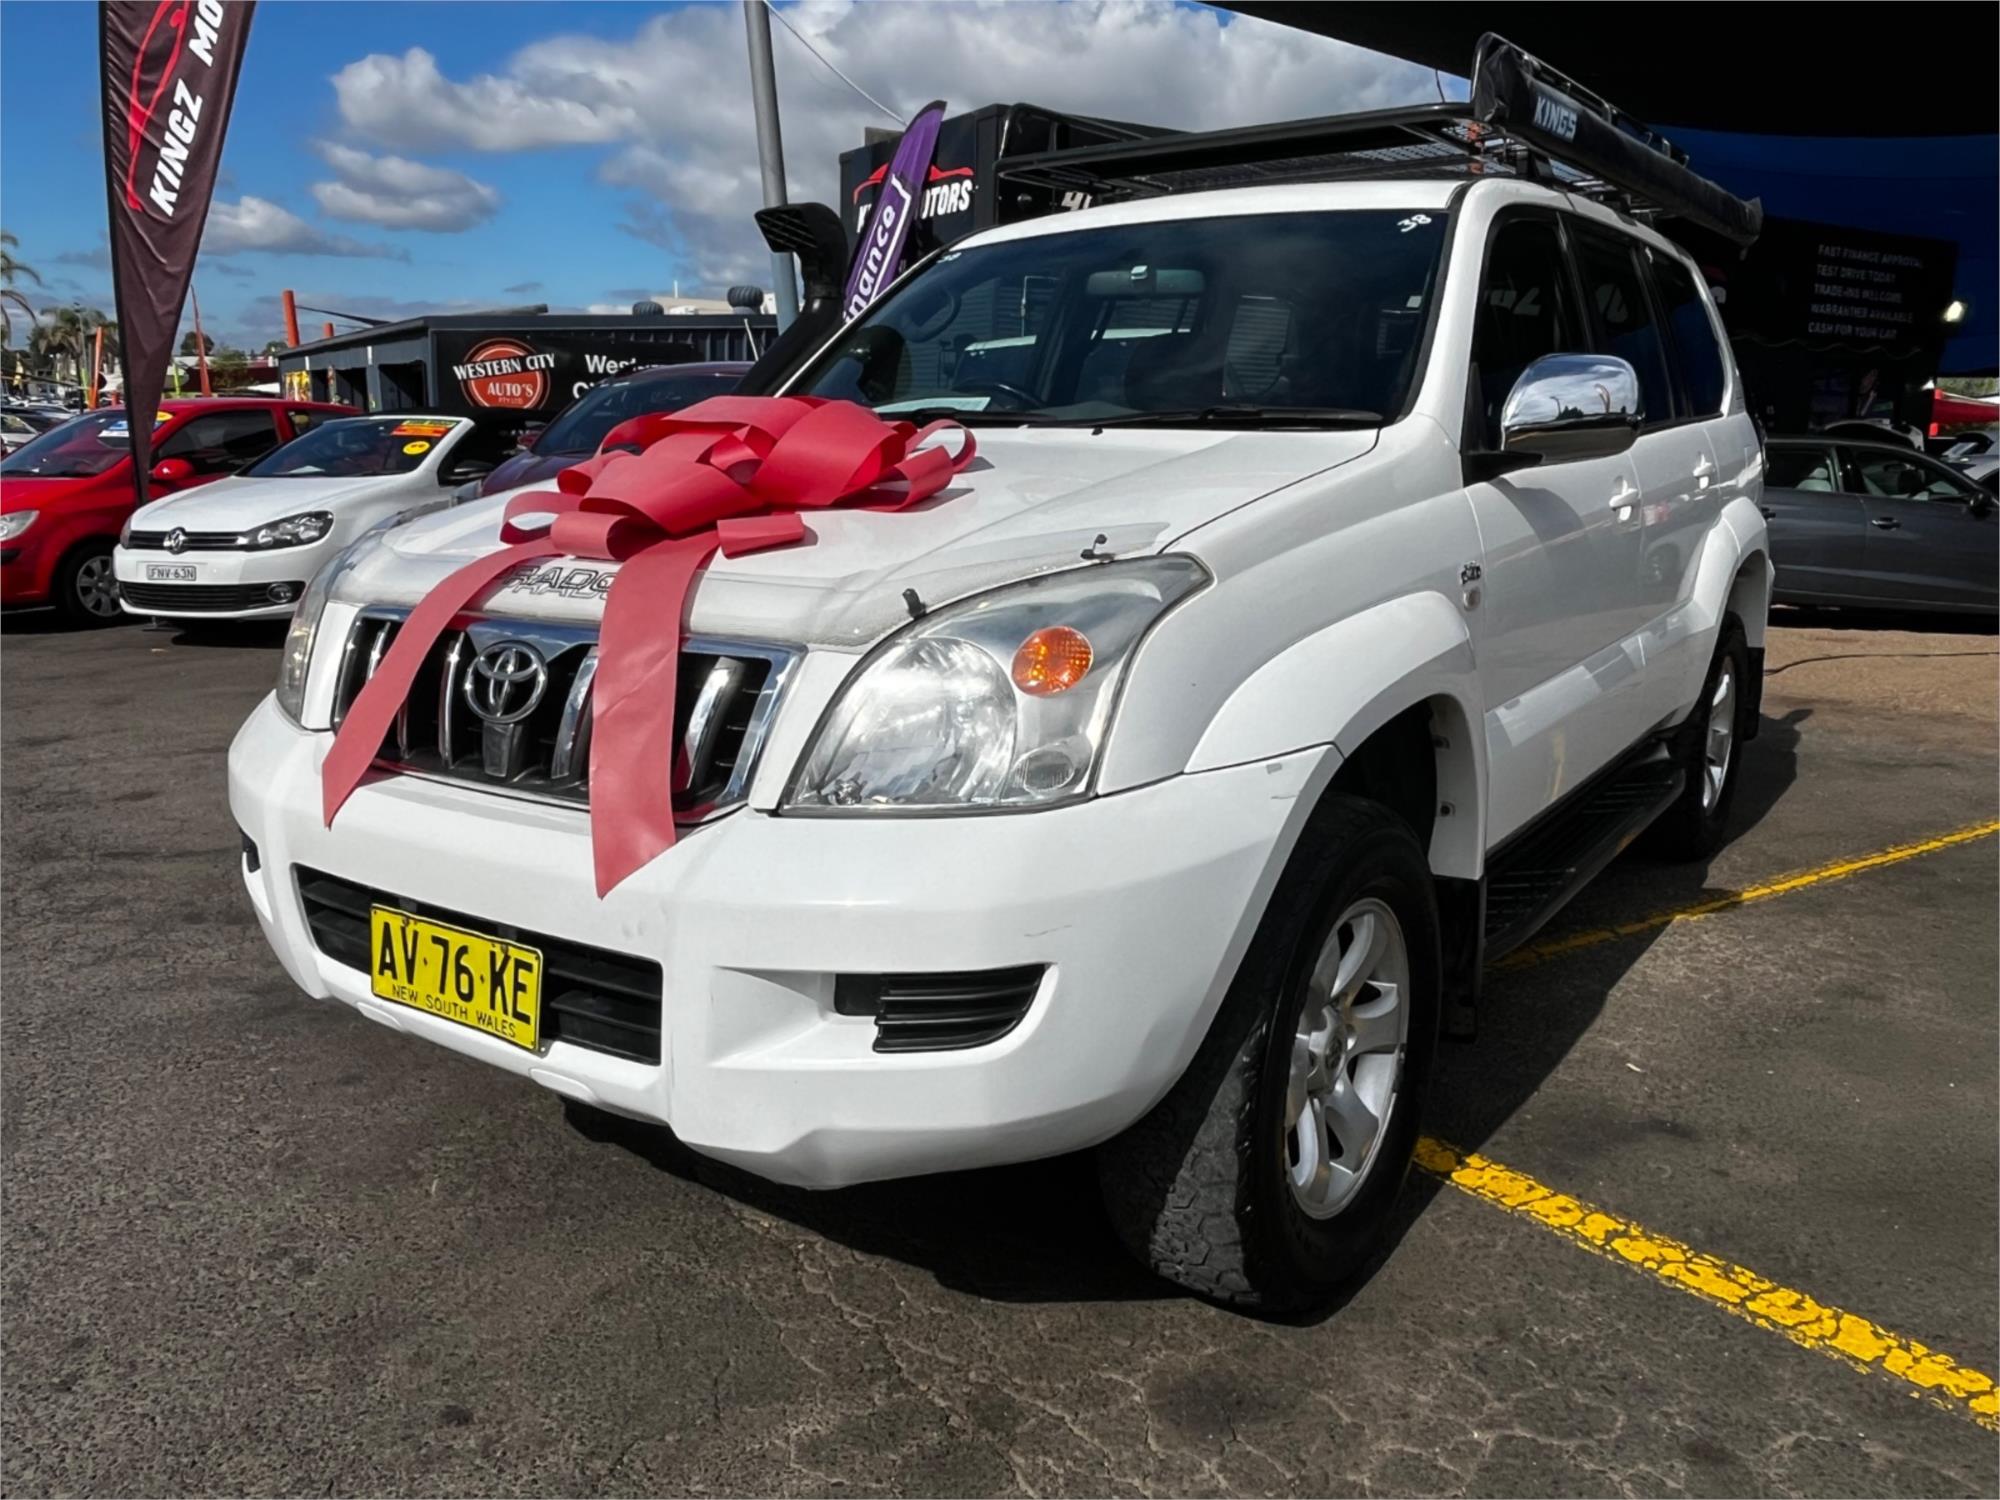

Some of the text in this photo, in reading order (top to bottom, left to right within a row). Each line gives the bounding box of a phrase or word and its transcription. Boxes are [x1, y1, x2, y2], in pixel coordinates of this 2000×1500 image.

[150, 78, 203, 217] KINGZ
[453, 353, 556, 381] WESTERN CITY
[391, 984, 517, 1039] NEW SOUTH WALES
